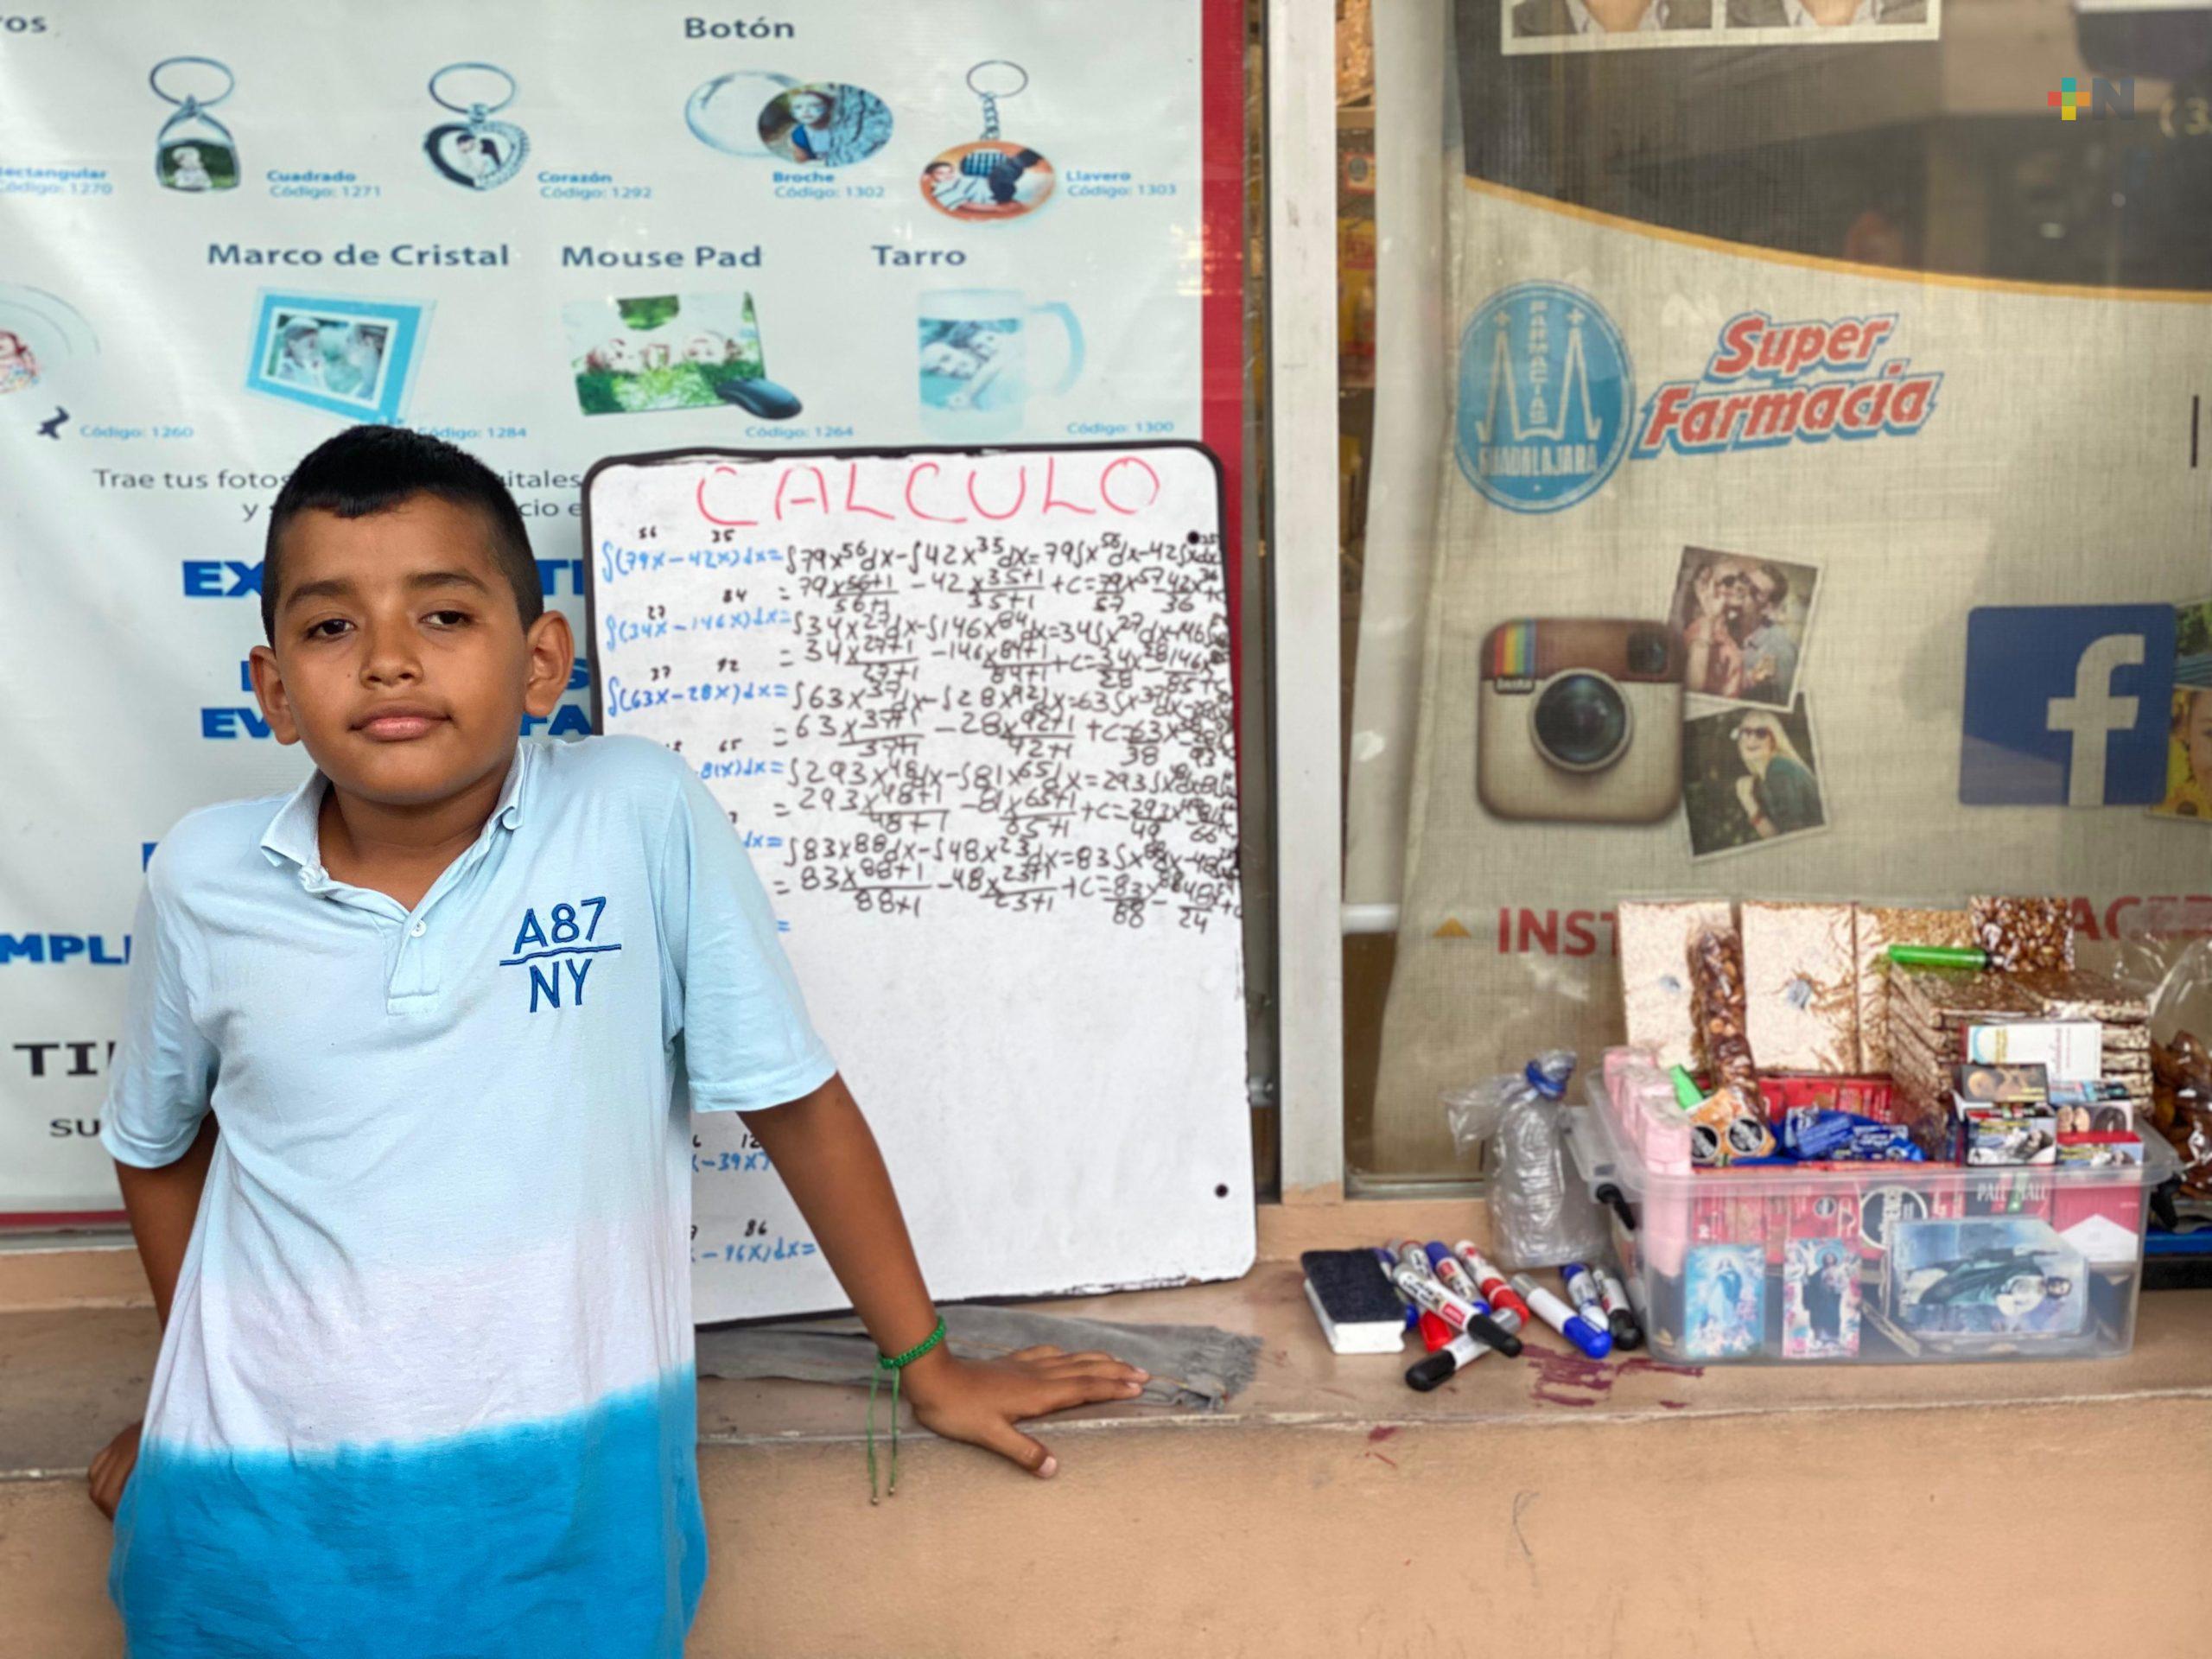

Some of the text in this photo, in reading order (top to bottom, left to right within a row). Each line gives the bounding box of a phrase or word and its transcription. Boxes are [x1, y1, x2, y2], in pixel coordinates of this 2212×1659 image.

[684, 16, 795, 39] Botón
[266, 169, 357, 182] Cuadrado
[537, 172, 613, 183] Corazón
[772, 172, 835, 182] Broche
[1065, 171, 1132, 182] Llavero
[71, 182, 114, 195] 1270
[270, 185, 383, 200] Código: 1271
[540, 186, 652, 200] Código: 1292
[775, 187, 885, 200] Código: 1302
[1067, 184, 1177, 200] Código: 1303
[208, 243, 509, 266] Marco de Cristal
[562, 245, 762, 268] Mouse Pad
[871, 245, 967, 267] Tarro
[1713, 313, 1896, 380] Super
[1643, 361, 1936, 448] Farmacia
[151, 425, 194, 438] 1260
[487, 426, 527, 438] 1284
[745, 425, 810, 440] Código:
[1066, 421, 1175, 435] Código: 1300
[92, 468, 155, 489] Trae
[164, 474, 208, 489] tus
[696, 456, 1160, 525] CALCULO
[242, 503, 259, 524] y
[513, 896, 607, 955] A87
[530, 957, 593, 1013] NY
